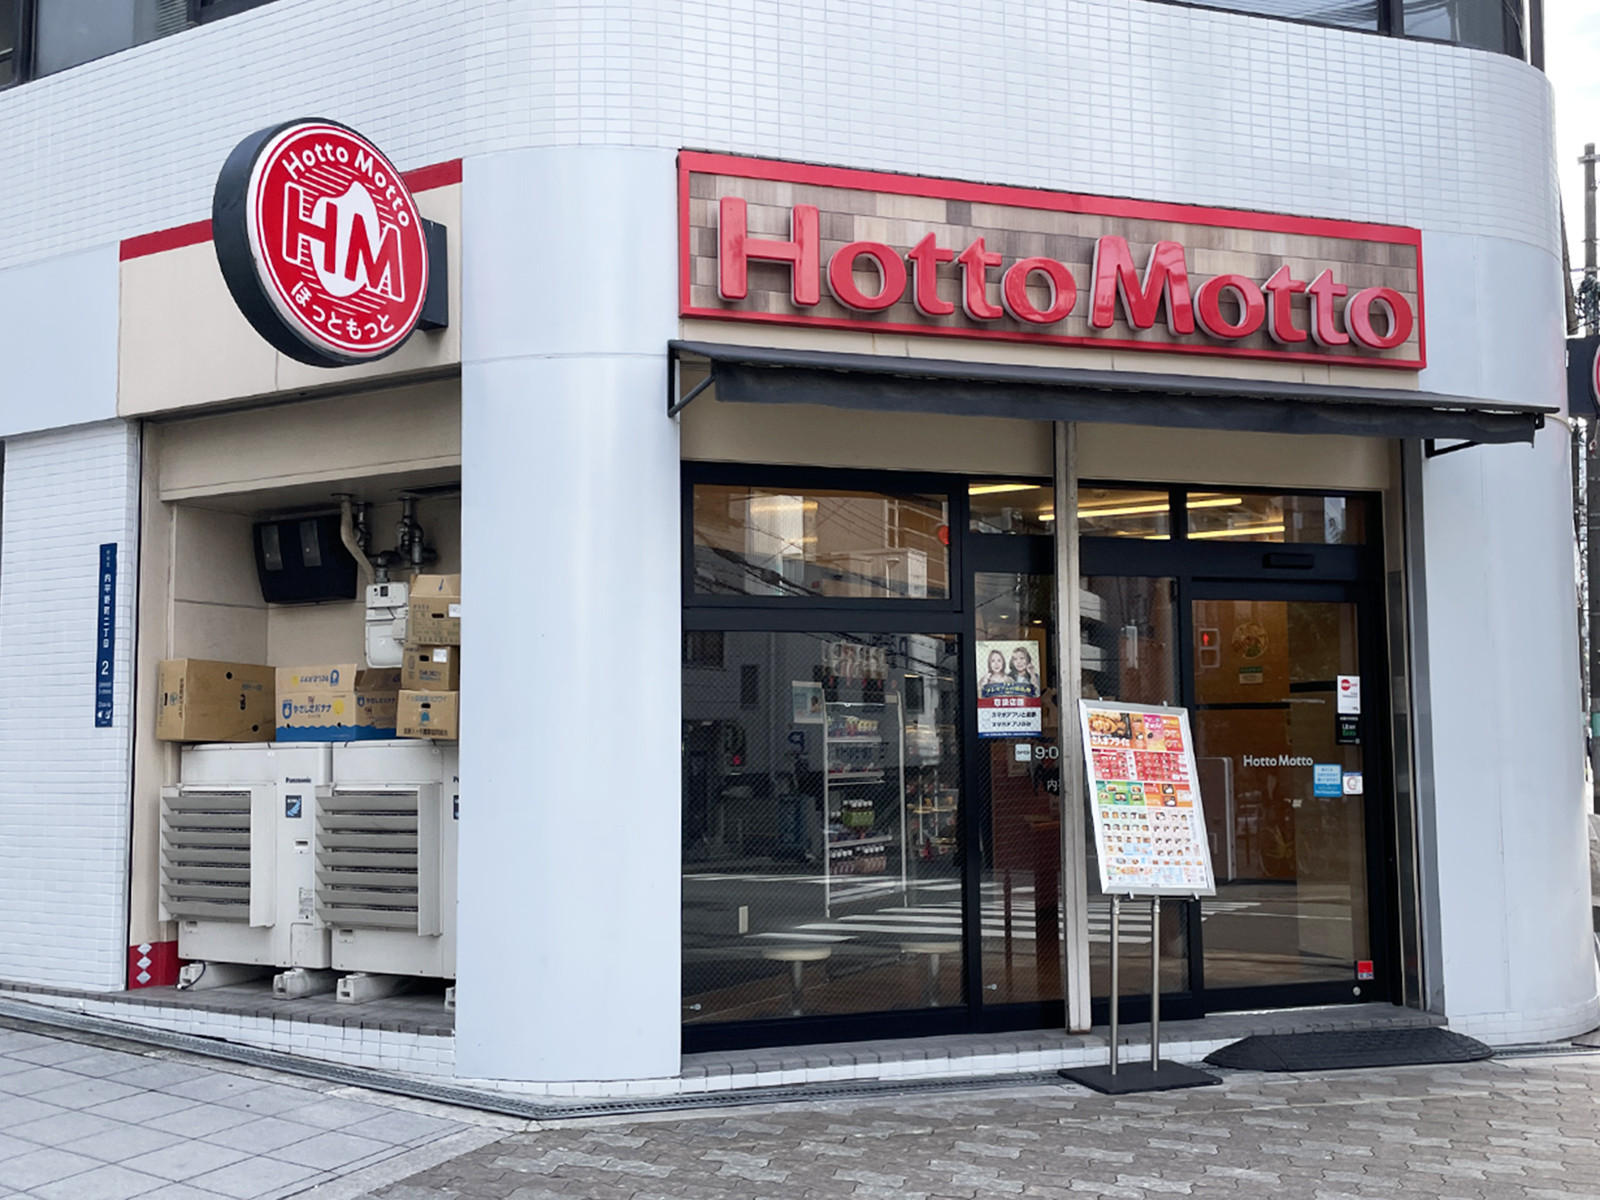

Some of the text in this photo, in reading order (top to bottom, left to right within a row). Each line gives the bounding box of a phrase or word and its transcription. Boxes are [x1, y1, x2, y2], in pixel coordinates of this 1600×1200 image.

[282, 142, 410, 228] Hotto Motto
[291, 281, 395, 340] ほっともっと
[101, 660, 109, 675] 2
[1243, 754, 1313, 767] Hotto Motto
[1046, 778, 1060, 793] 内
